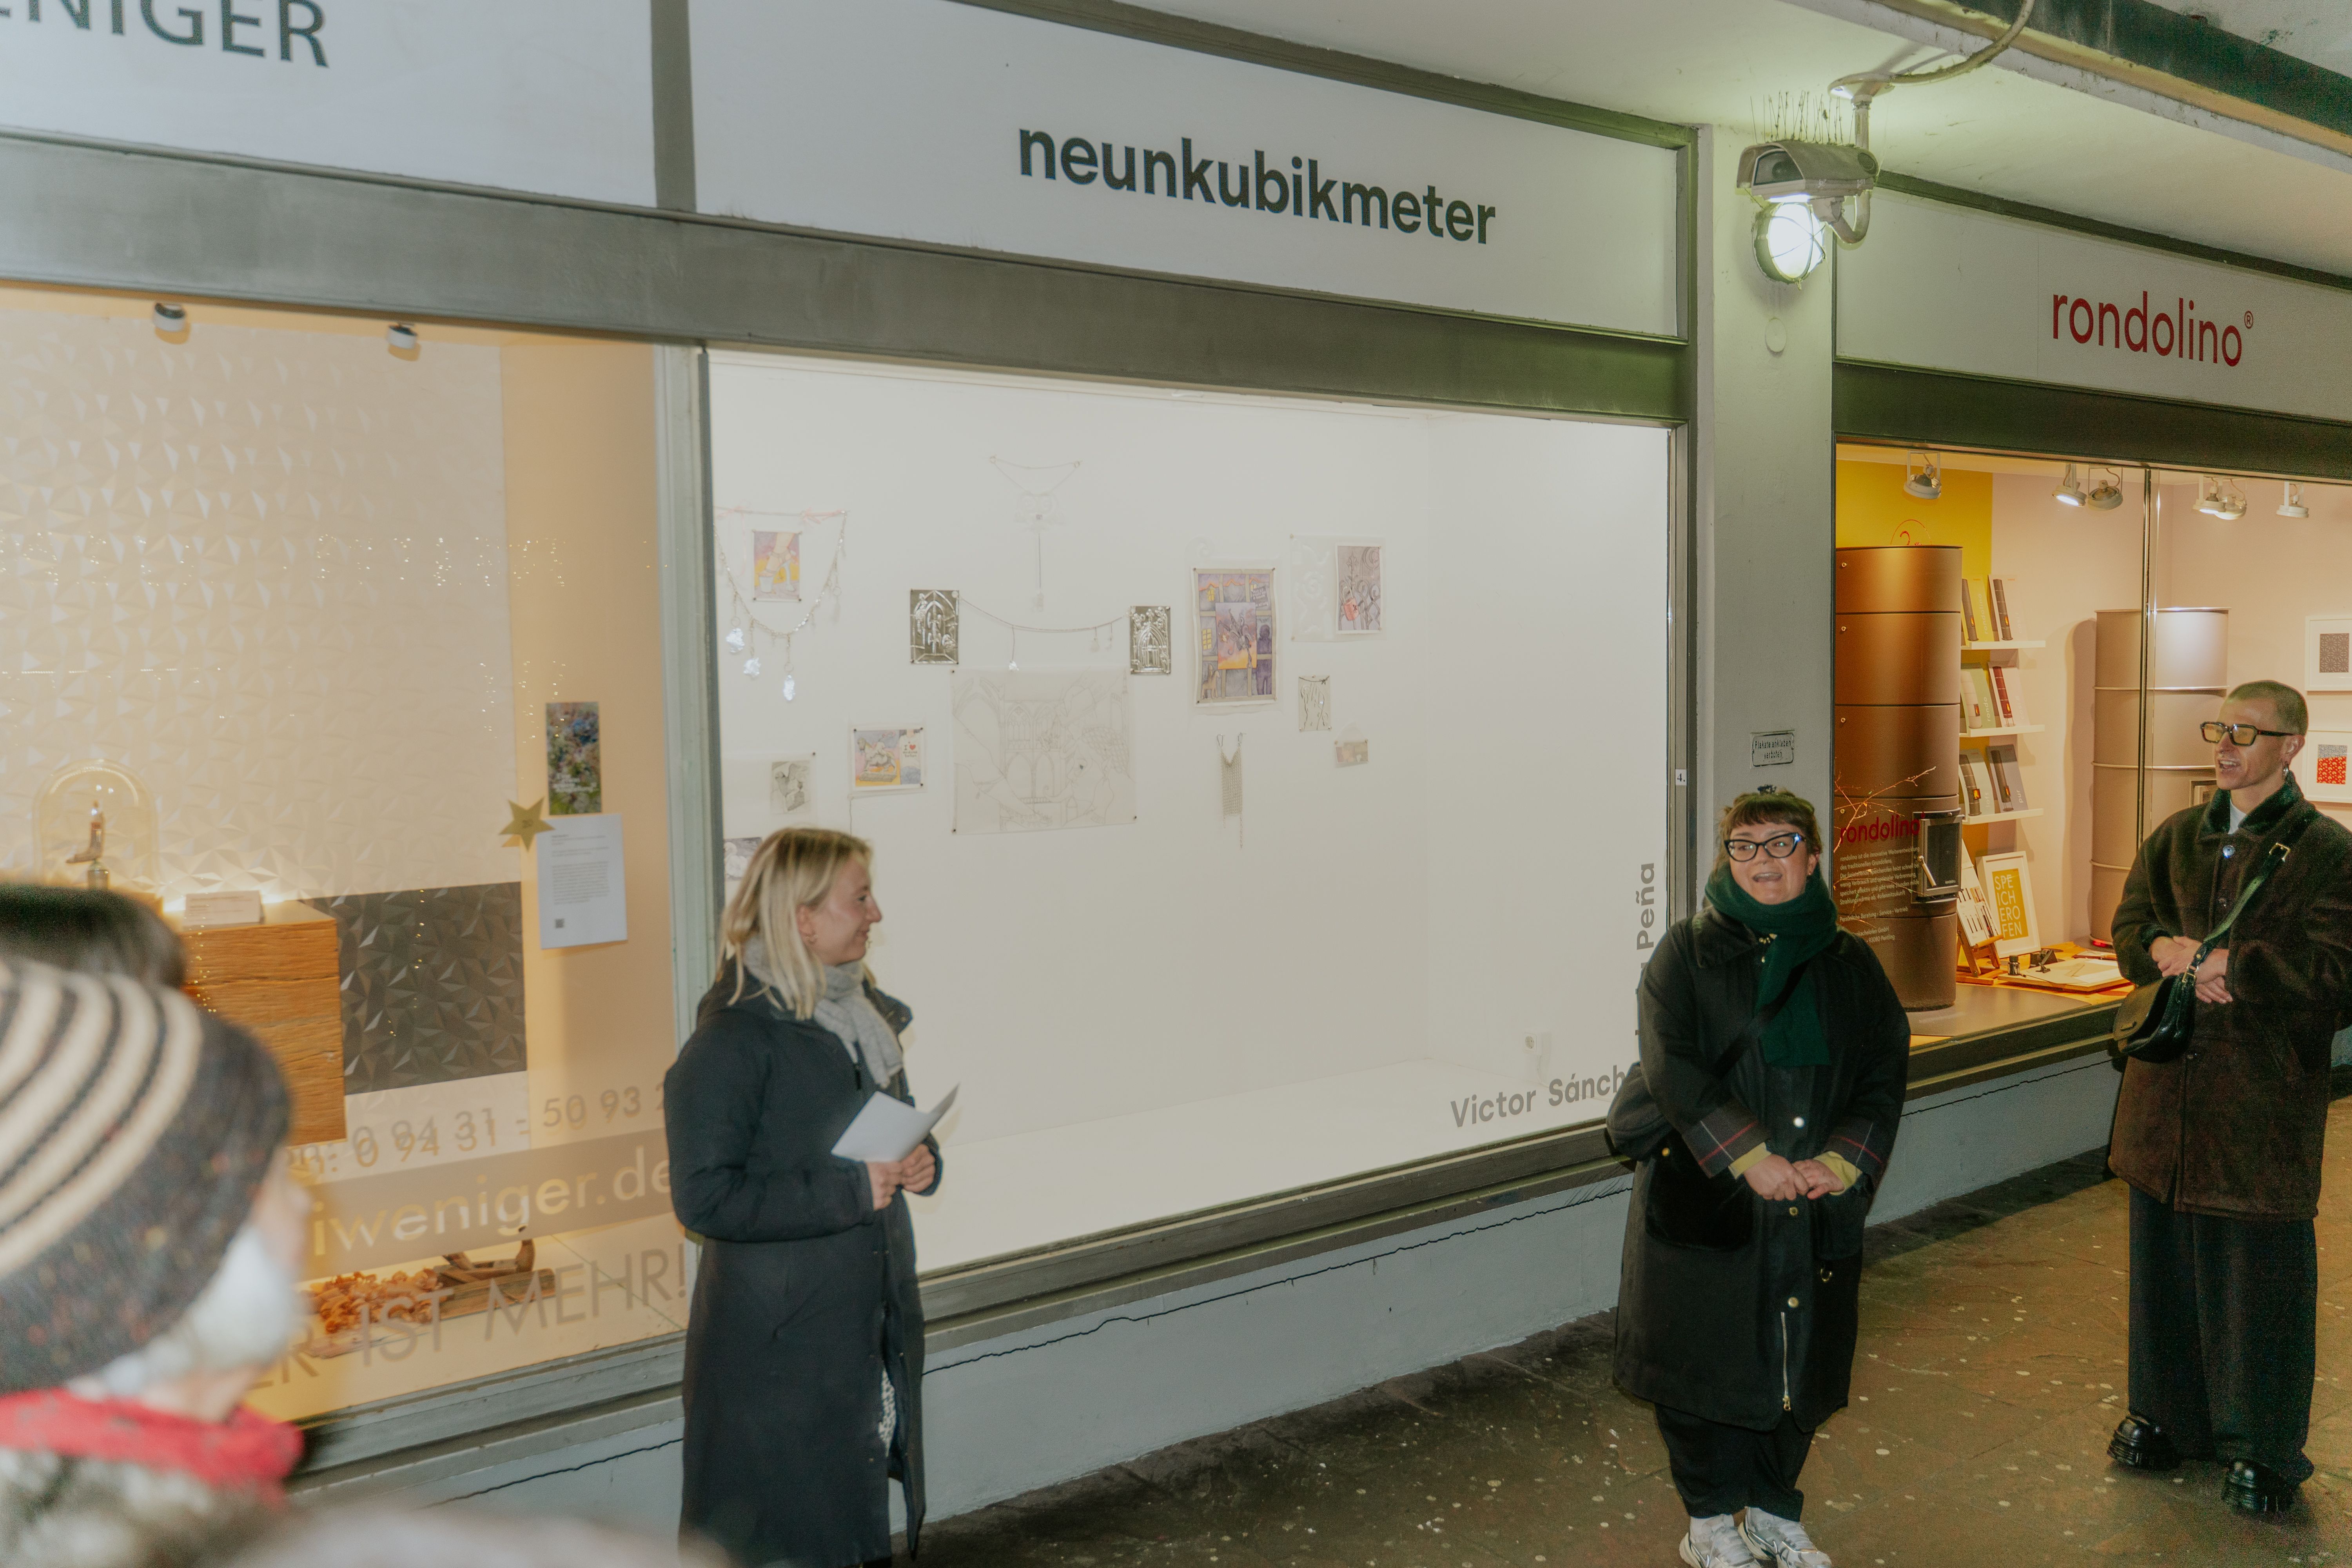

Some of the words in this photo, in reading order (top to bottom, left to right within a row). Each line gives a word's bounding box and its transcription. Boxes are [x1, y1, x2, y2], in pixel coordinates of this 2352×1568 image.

[1019, 128, 1496, 245] neunkubikmeter
[1755, 740, 1770, 749] Plakate
[1772, 739, 1791, 748] ankleben
[1764, 750, 1782, 759] verboten
[1677, 773, 1685, 782] 4.
[1840, 812, 1925, 844] rondolino
[1994, 874, 2013, 891] SPE
[1636, 863, 1654, 950] Peña
[1997, 890, 2016, 906] ICH
[2000, 906, 2020, 922] ERO
[2002, 922, 2022, 938] FEN
[544, 1095, 587, 1130] 50
[601, 1085, 641, 1122] 93
[1450, 1090, 1536, 1127] Victor
[357, 1287, 454, 1367] IST
